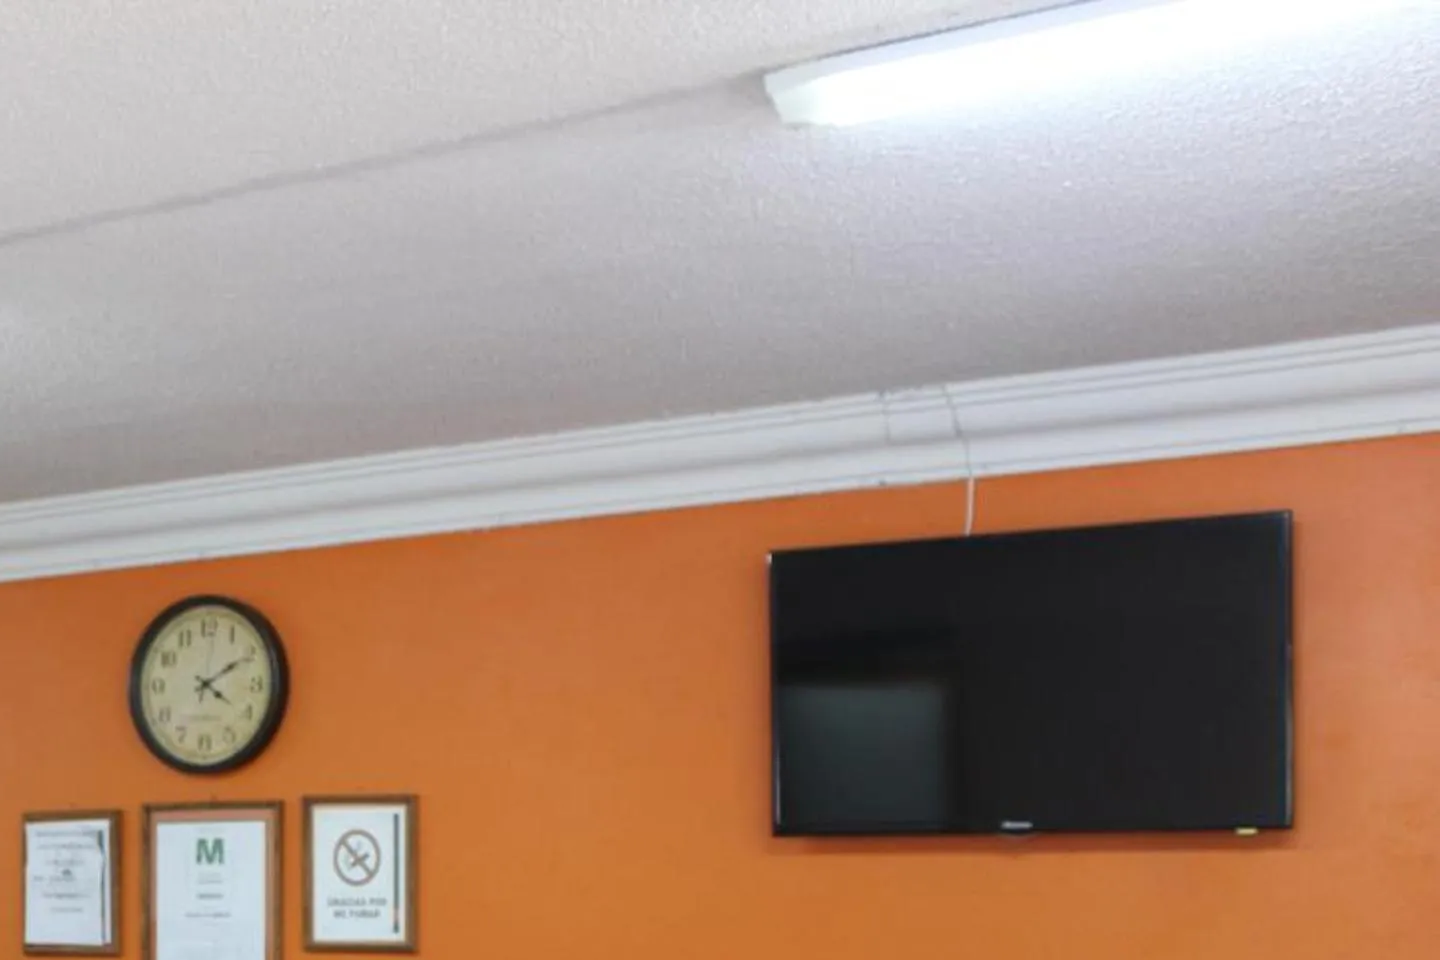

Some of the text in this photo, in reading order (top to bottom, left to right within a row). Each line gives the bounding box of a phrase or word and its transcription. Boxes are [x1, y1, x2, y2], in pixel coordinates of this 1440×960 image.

[201, 617, 218, 638] 12
[228, 624, 236, 645] 1
[178, 629, 192, 648] 11
[160, 650, 177, 669] 10
[151, 677, 166, 695] 9
[249, 676, 263, 694] 3
[239, 703, 253, 721] 4
[175, 724, 188, 744] 7
[196, 838, 225, 865] M
